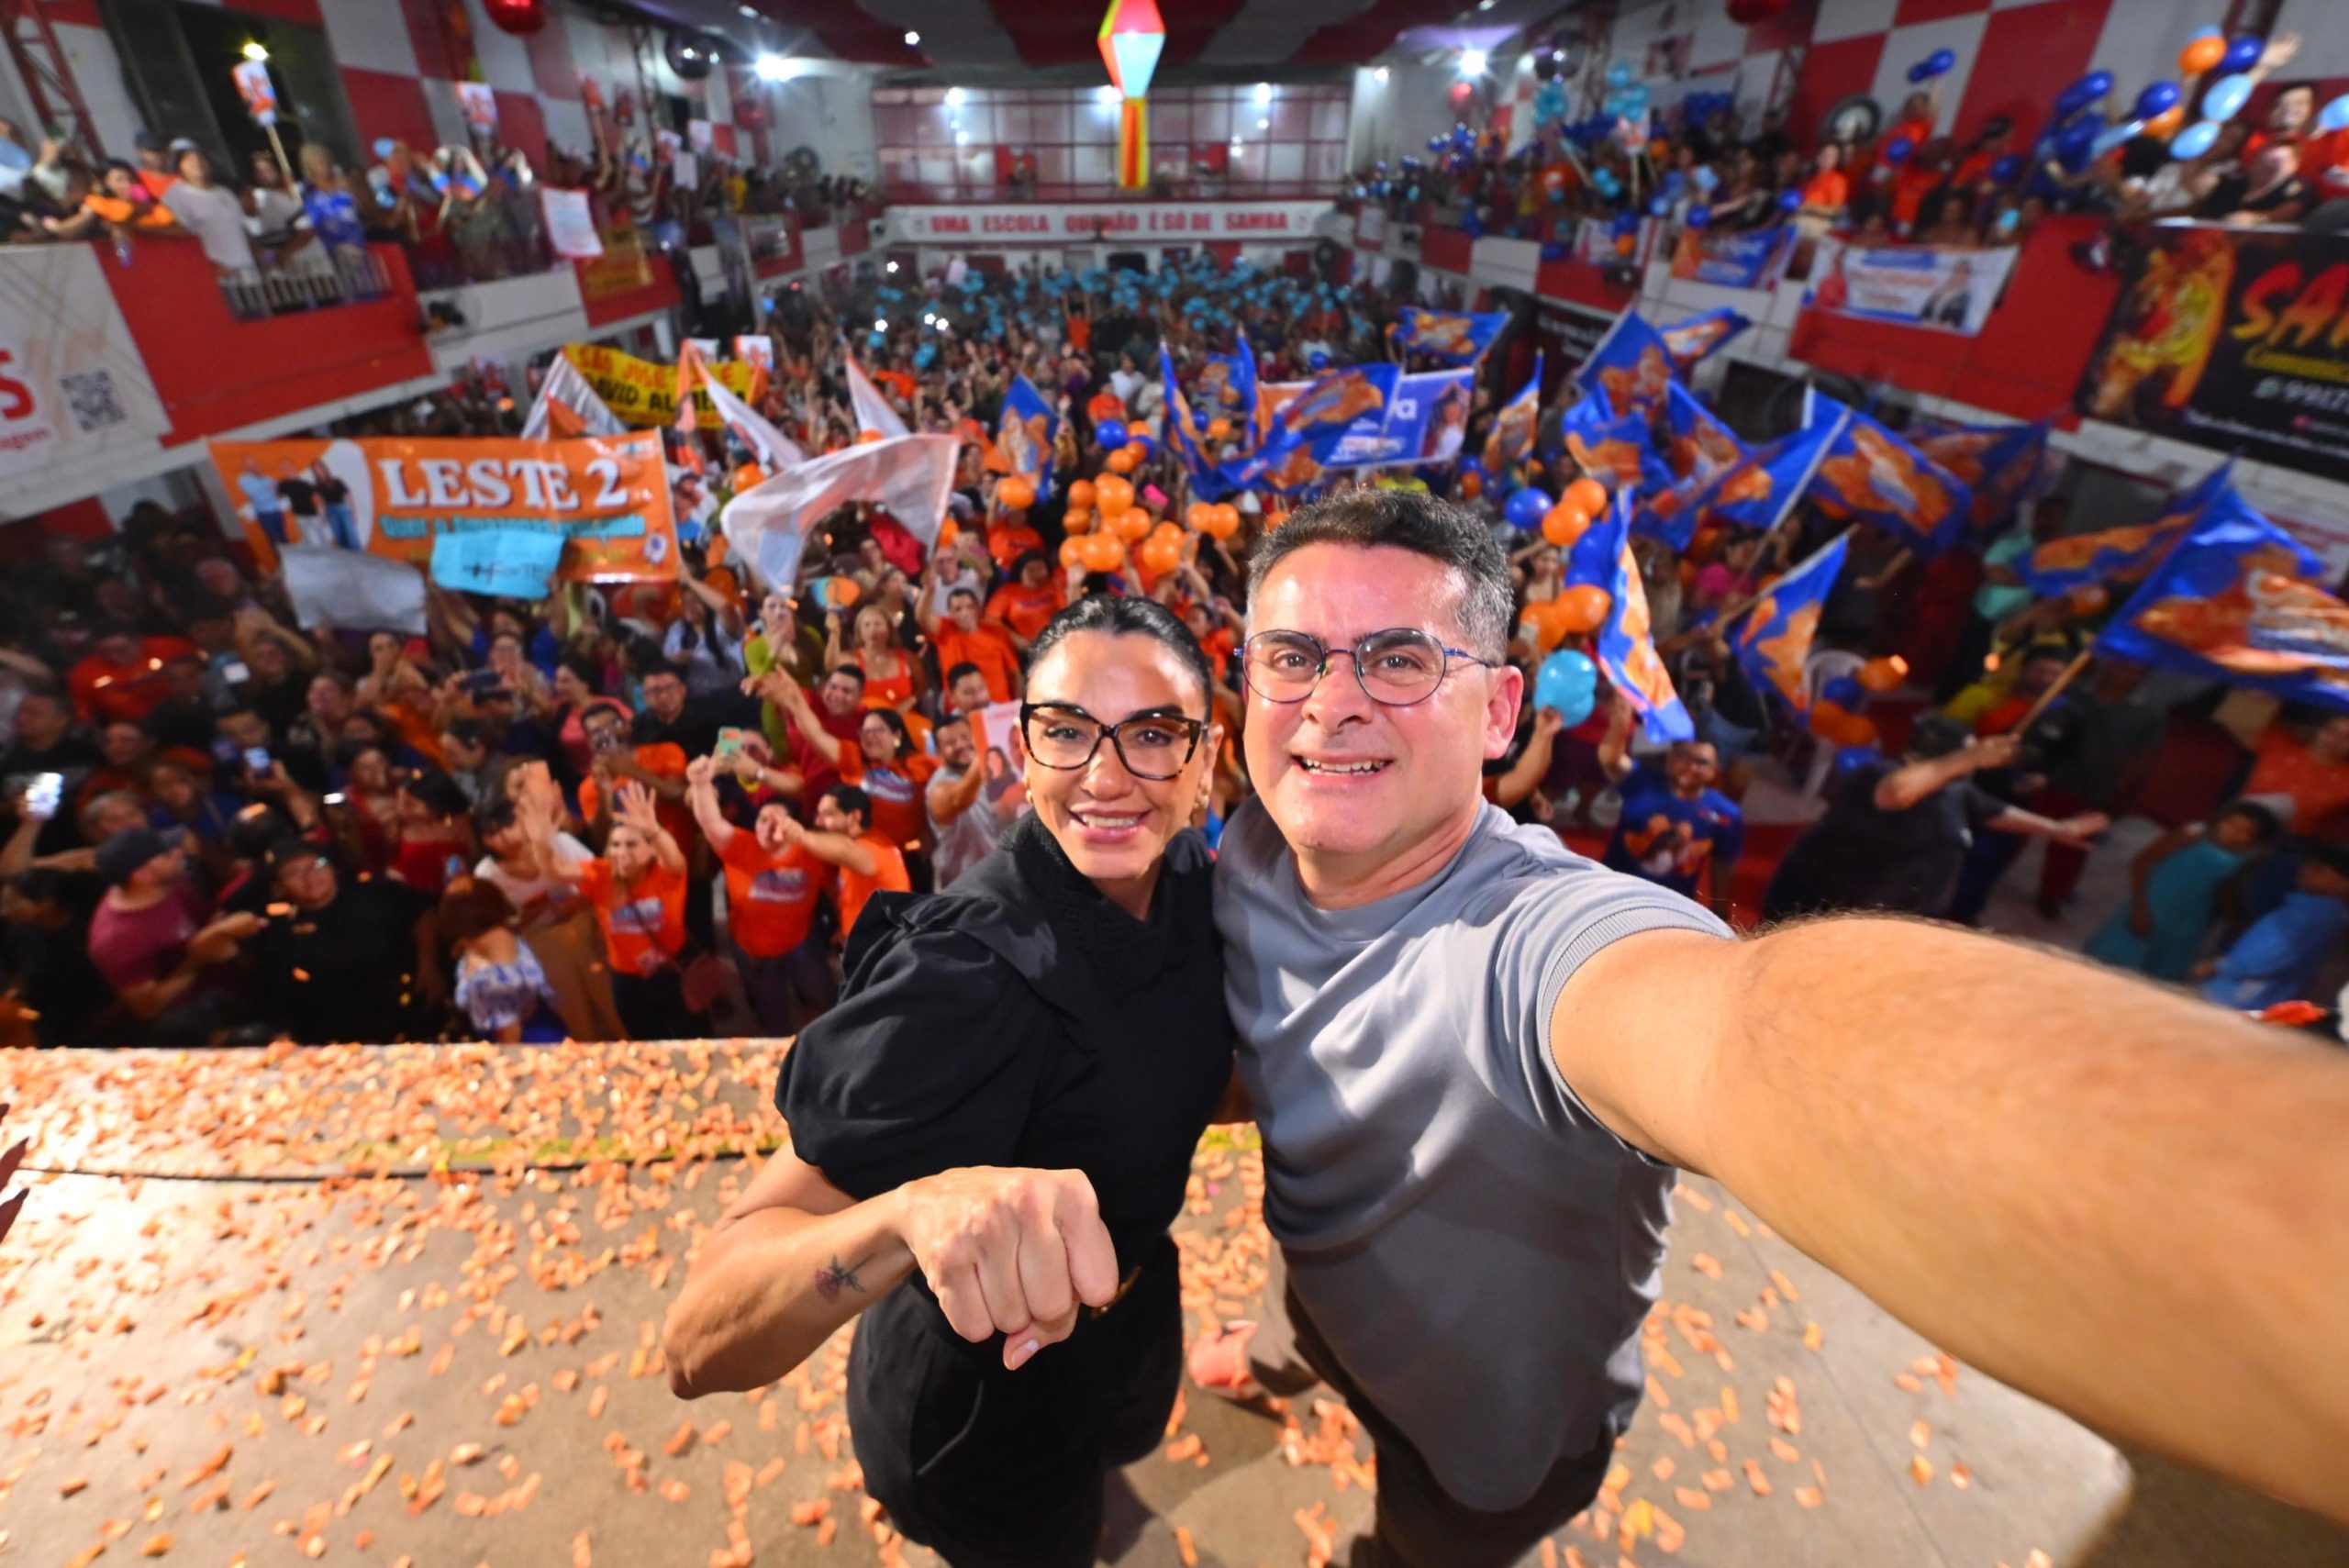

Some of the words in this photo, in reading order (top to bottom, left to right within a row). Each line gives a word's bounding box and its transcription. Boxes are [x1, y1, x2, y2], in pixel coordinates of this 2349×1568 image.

[931, 214, 971, 233] UMA
[983, 214, 1049, 233] ESCOLA
[1225, 211, 1289, 230] SAMBA
[377, 458, 581, 510] LESTE
[585, 459, 629, 508] 2
